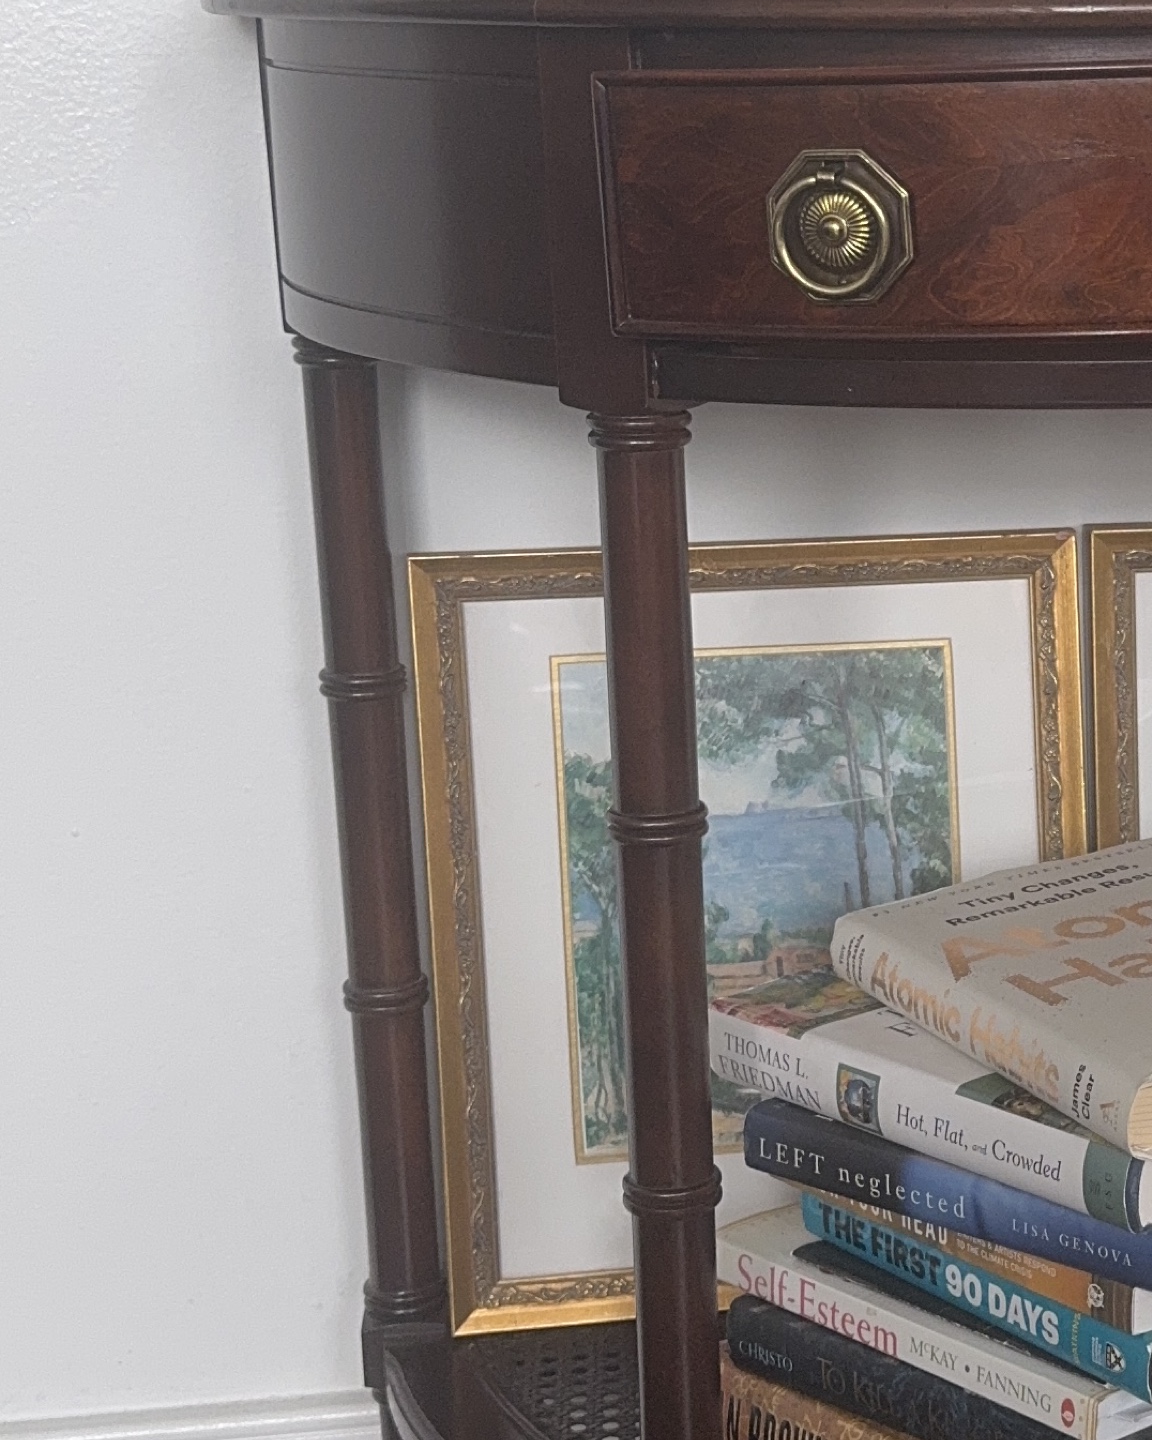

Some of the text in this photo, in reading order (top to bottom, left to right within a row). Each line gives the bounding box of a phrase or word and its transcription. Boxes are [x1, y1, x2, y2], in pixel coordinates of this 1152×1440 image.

[945, 886, 1097, 927] Remarkable
[958, 863, 1139, 909] Tiny Changes,
[870, 951, 962, 1043] Atomic
[724, 1031, 809, 1079] THOMAS L.
[718, 1054, 822, 1111] FRIEDMAN
[1069, 1063, 1087, 1118] James
[1082, 1073, 1096, 1120] Clear
[896, 1103, 1062, 1182] Hot, Flat, and Crowded
[759, 1137, 826, 1175] LEFT
[838, 1165, 966, 1220] neglected
[981, 1250, 1010, 1269] CLIMATE
[1012, 1218, 1133, 1268] LISA GENOVA
[819, 1202, 867, 1252] THE
[871, 1226, 942, 1287] FIRST
[945, 1263, 983, 1308] 90
[987, 1282, 1060, 1346] DAYS
[738, 1254, 898, 1358] Self-Esteem
[977, 1365, 1052, 1413] FANNING
[739, 1340, 793, 1374] CHRISTO
